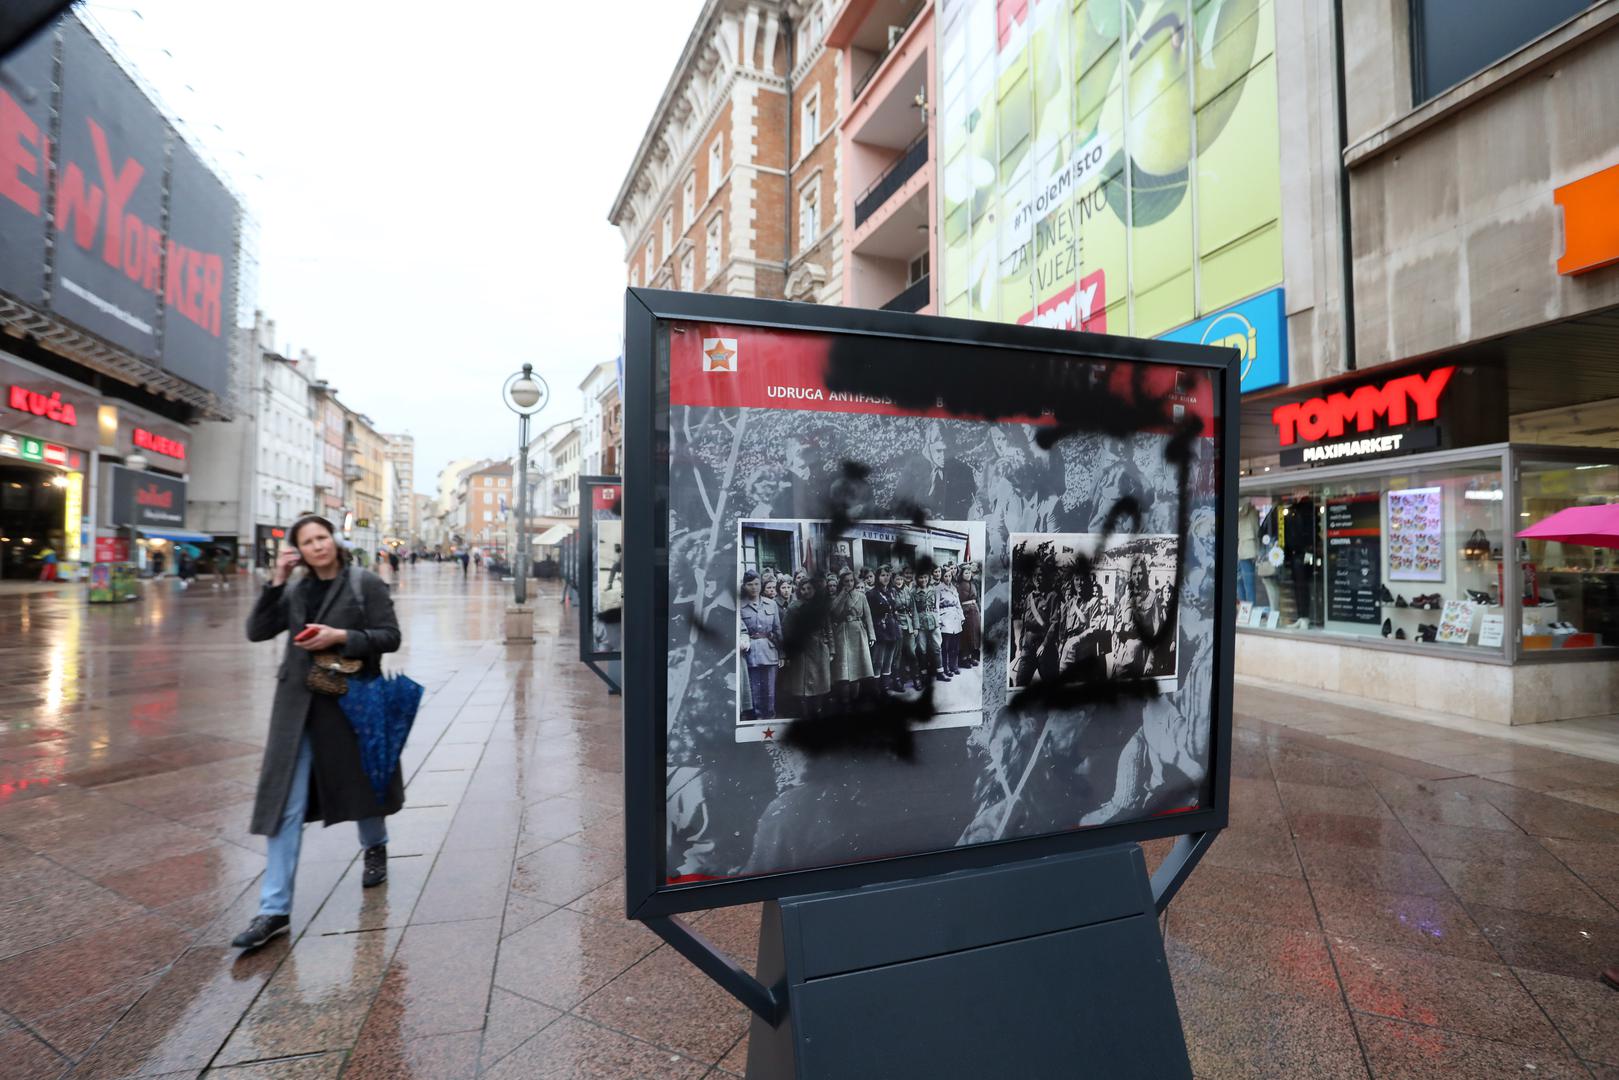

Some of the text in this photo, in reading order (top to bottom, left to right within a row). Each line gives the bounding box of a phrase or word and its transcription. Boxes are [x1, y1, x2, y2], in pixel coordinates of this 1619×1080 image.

[1024, 282, 1098, 331] MMY
[767, 385, 824, 400] UDRUGA
[1272, 365, 1456, 447] TOMMY
[1303, 433, 1404, 463] MAXIMARKET
